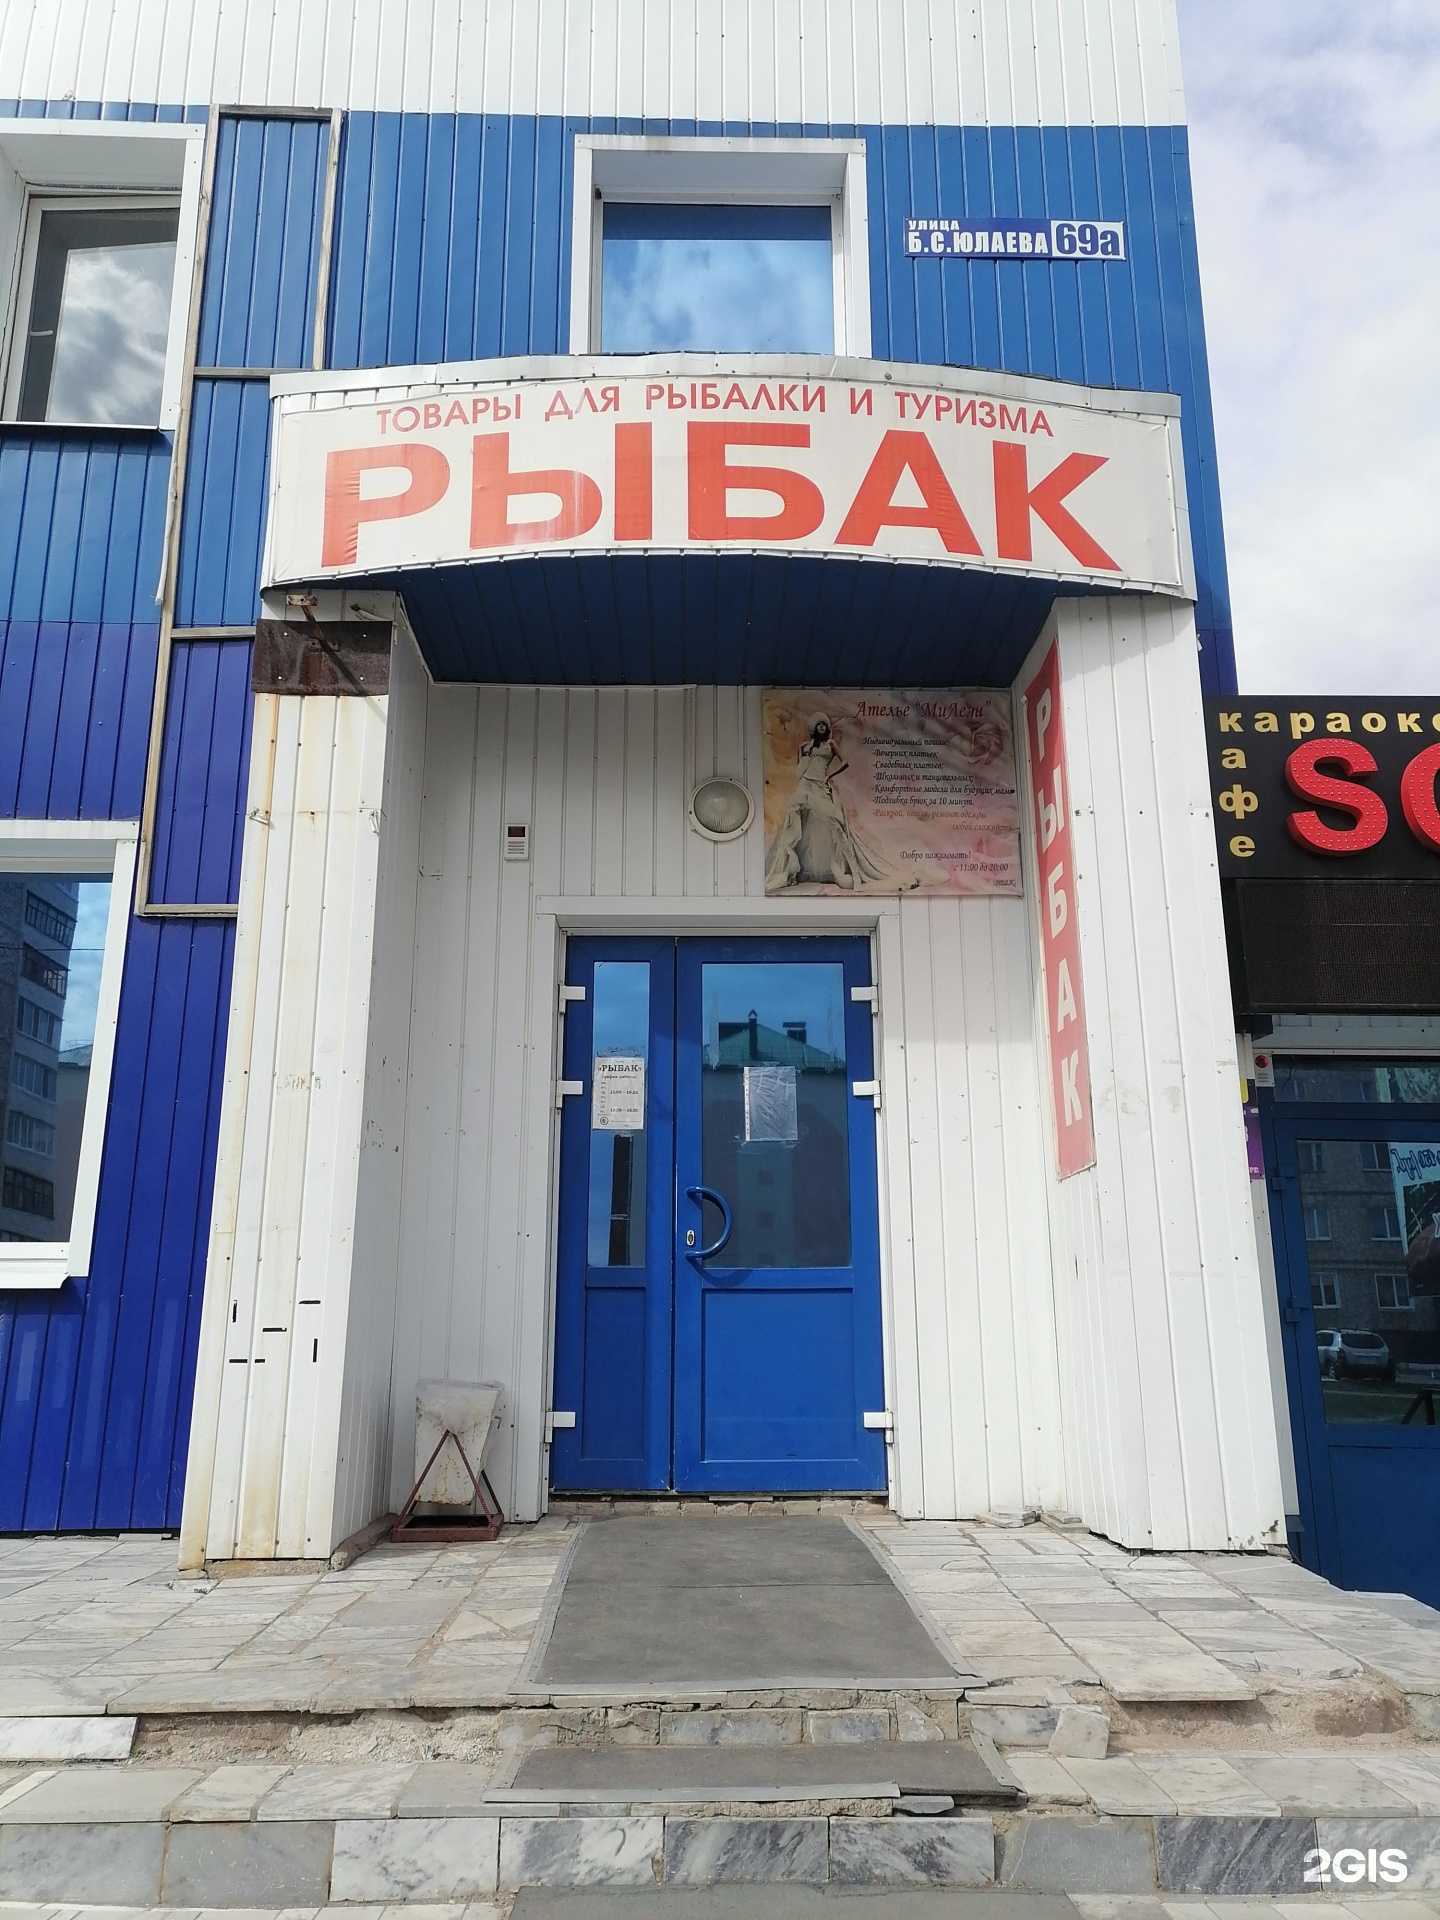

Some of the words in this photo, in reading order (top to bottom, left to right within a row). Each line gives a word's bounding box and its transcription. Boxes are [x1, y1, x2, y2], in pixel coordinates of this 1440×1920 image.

[908, 219, 960, 232] УЛИЦА
[908, 231, 1049, 254] Б.С.ЮЛАЕВА
[1055, 222, 1120, 256] 69а
[376, 393, 522, 435] ТОВАРЫ
[544, 386, 621, 422] ДЛЯ
[645, 382, 827, 411] РЫБАЛКИ
[849, 387, 873, 416] И
[894, 391, 1055, 438] ТУРИЗМА
[321, 420, 1123, 574] РЫБАК
[857, 700, 910, 719] Ателье
[1034, 686, 1085, 1128] РЫБАК
